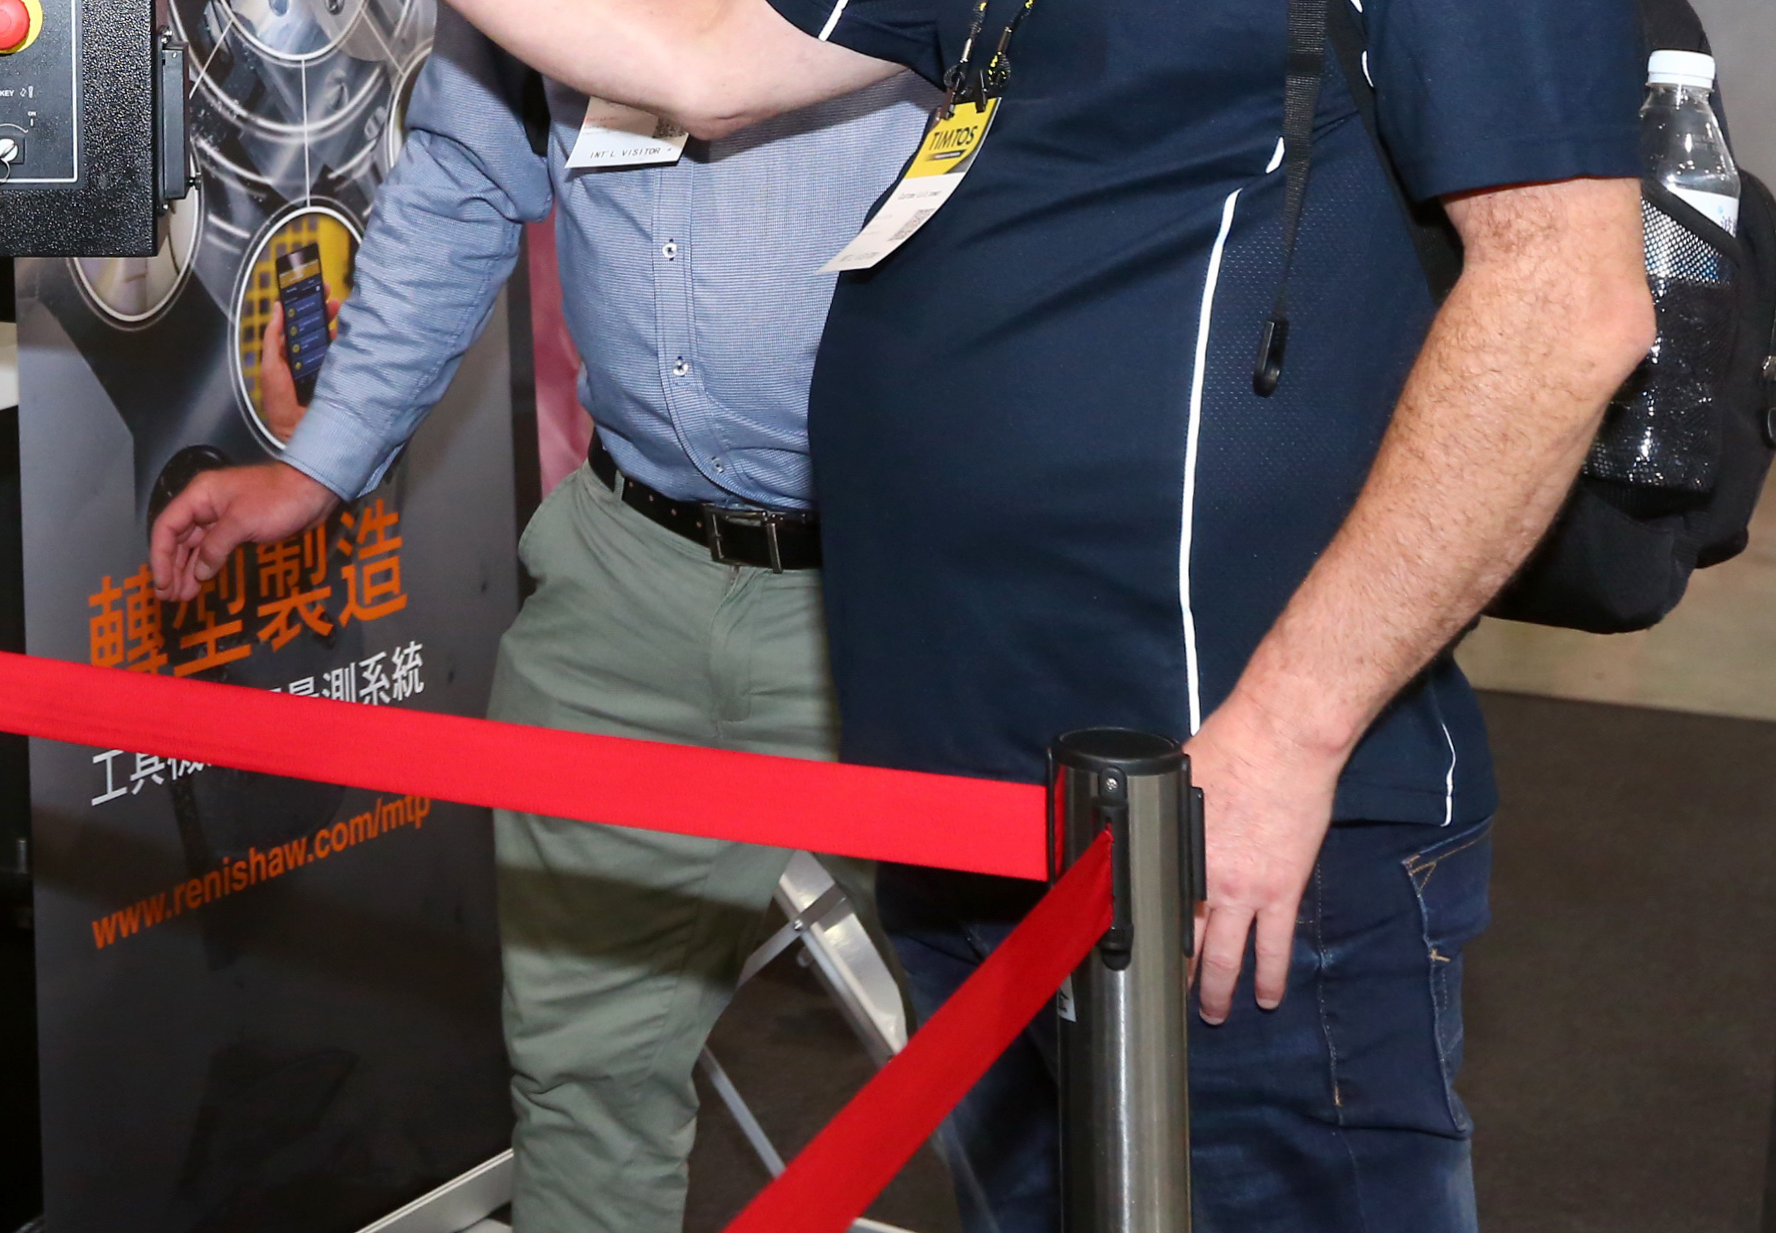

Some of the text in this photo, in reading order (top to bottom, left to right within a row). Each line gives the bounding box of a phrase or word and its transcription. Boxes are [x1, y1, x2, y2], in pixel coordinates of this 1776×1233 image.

[0, 89, 14, 97] KEY
[928, 125, 978, 151] TIMTOS
[621, 147, 661, 157] VISITOR
[87, 498, 409, 678] 轉型製造
[91, 795, 432, 950] www.renishaw.com/mtp
